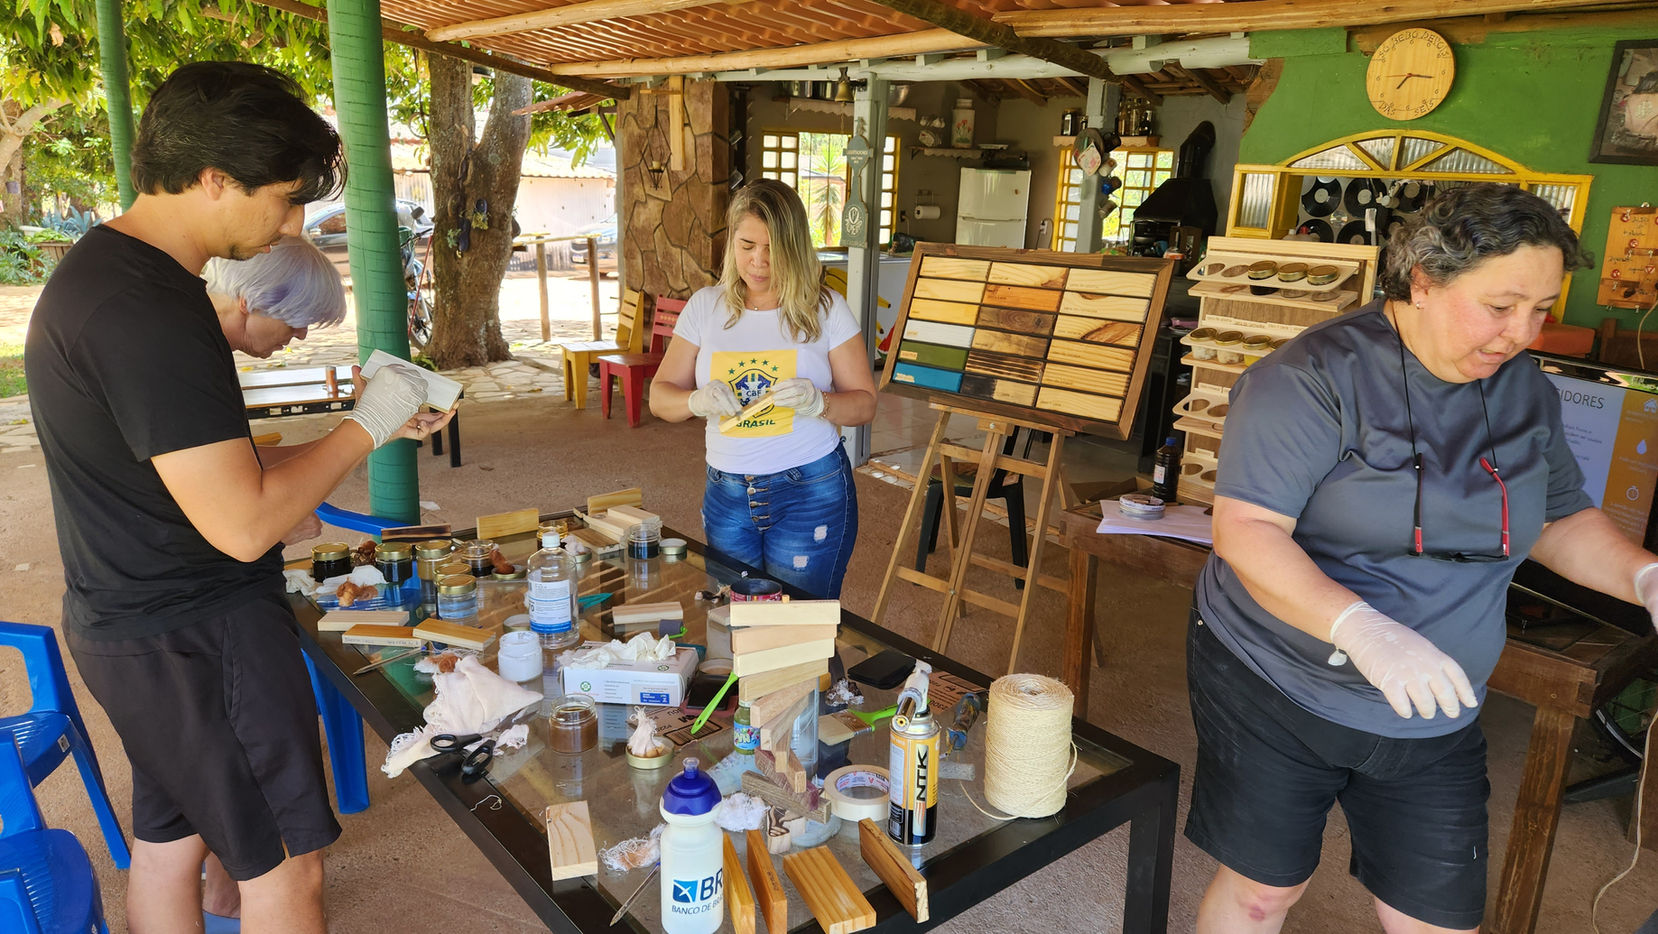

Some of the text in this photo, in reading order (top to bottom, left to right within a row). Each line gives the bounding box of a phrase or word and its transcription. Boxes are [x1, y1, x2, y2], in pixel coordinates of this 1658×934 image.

[916, 749, 929, 802] NTK
[671, 904, 700, 915] BANCO
[701, 902, 711, 913] DE
